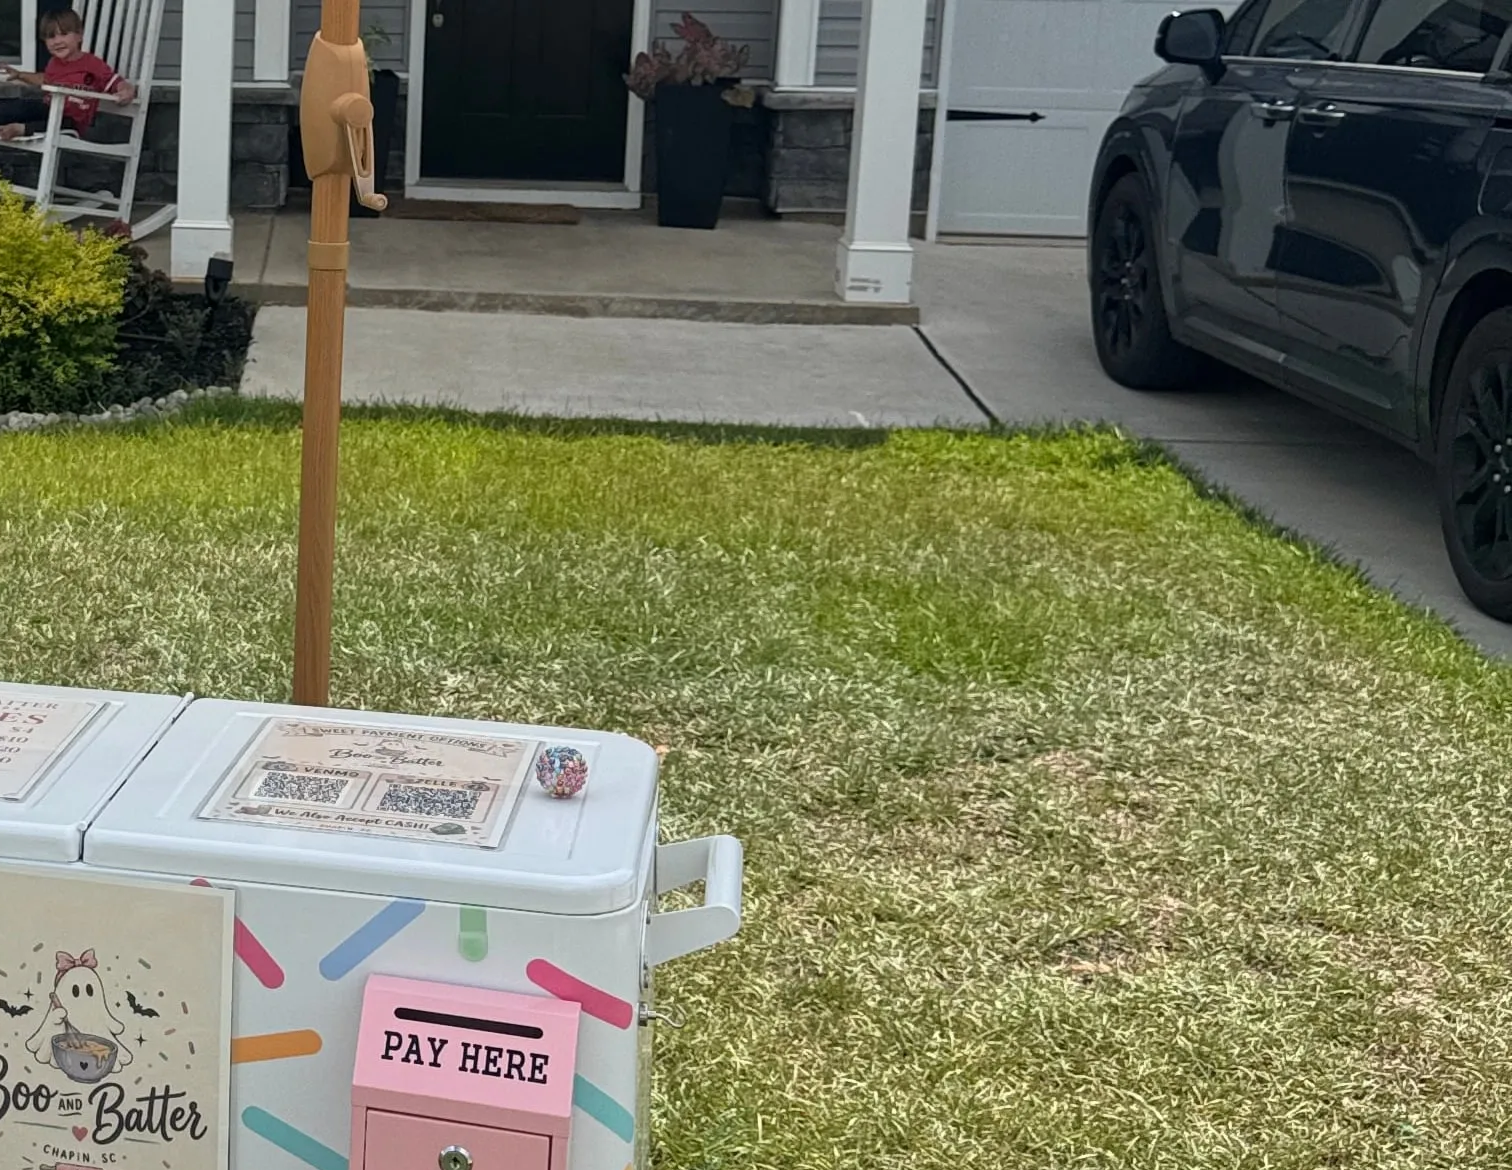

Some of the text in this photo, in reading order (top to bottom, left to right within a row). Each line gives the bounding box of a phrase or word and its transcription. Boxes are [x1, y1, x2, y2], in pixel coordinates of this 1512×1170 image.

[362, 729, 424, 741] PAYMENT
[429, 736, 487, 749] OPTIONS
[304, 766, 360, 777] VENMO
[381, 1030, 550, 1086] PAY HERE
[58, 1097, 83, 1111] AND
[87, 1081, 208, 1145] Batter
[101, 1152, 117, 1164] SC
